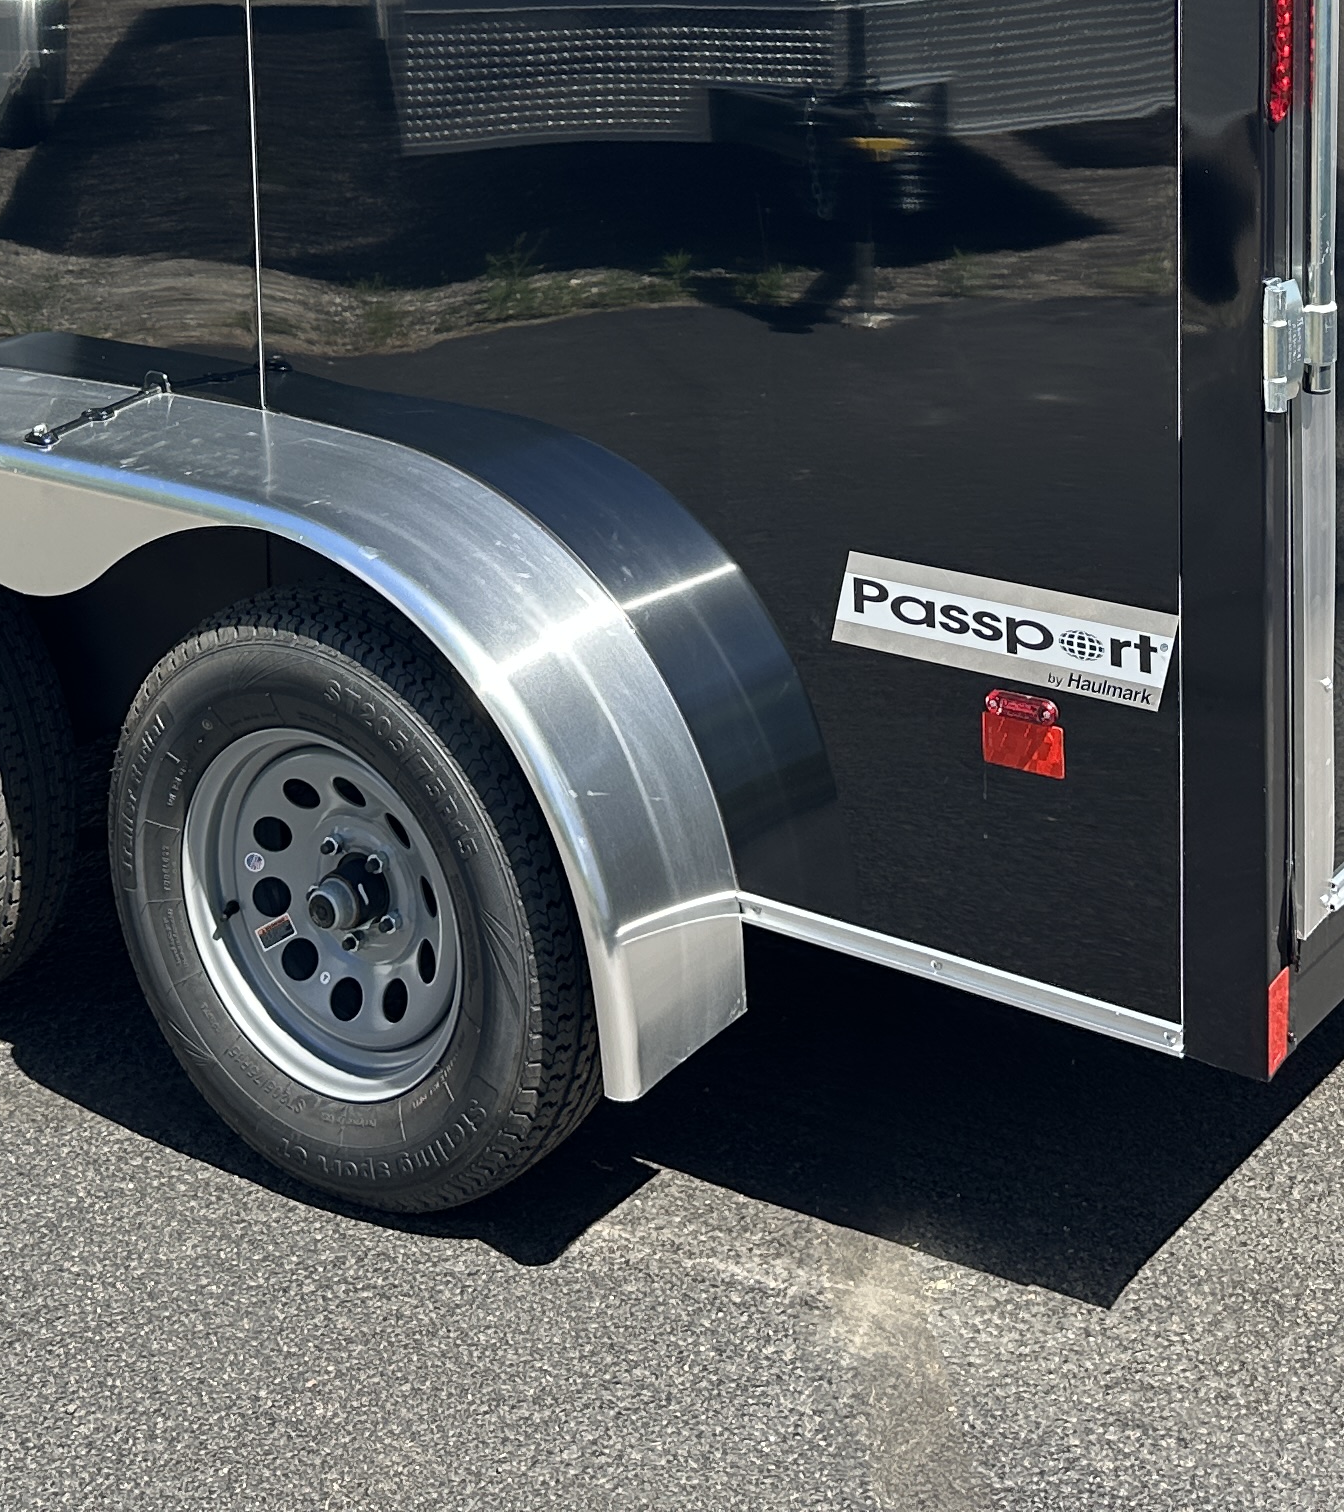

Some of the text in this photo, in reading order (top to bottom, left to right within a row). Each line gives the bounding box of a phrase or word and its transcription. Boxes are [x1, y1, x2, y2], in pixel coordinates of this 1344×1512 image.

[852, 576, 1159, 675] Passport
[1046, 672, 1153, 706] by Haulmark
[323, 678, 479, 856] ST205/75R15
